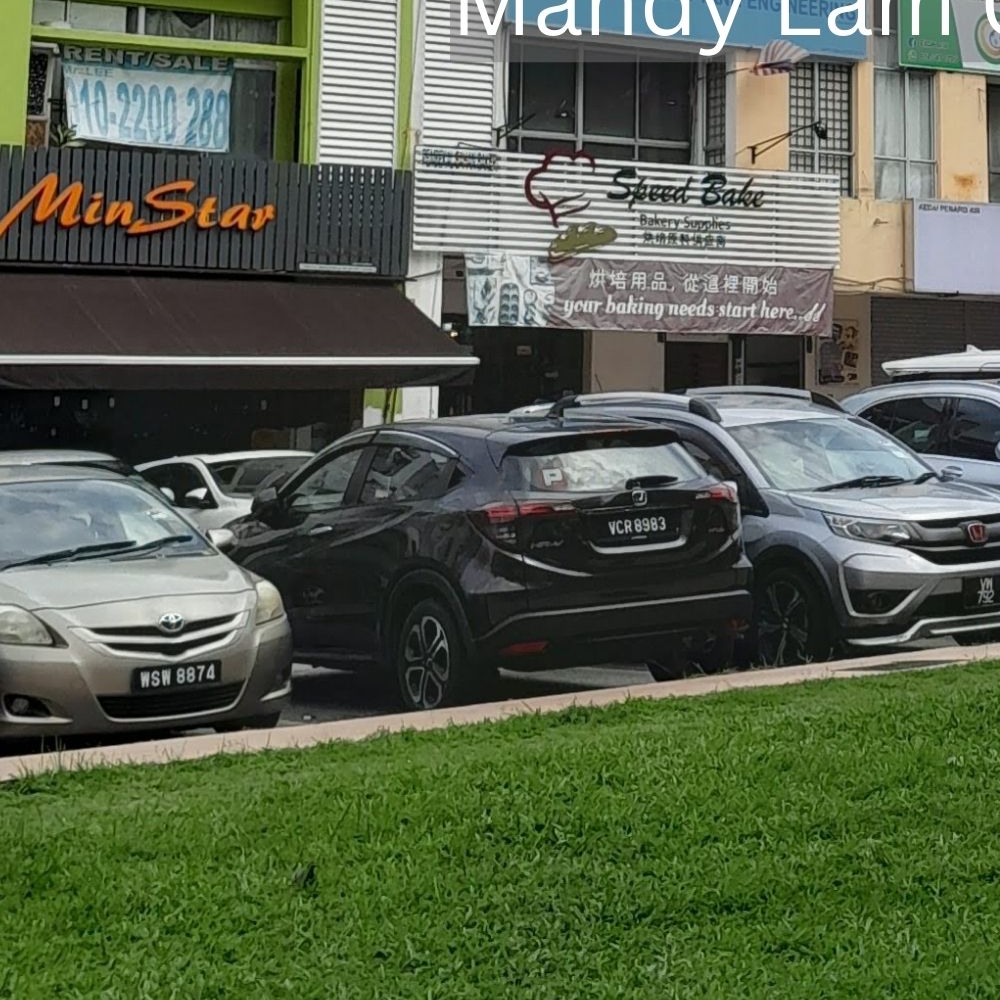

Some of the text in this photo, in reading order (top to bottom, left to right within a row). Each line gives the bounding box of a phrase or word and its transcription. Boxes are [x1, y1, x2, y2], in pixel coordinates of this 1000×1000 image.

[606, 167, 766, 210] Speed Bake
[640, 214, 682, 229] Bakery
[563, 298, 603, 319] your
[605, 294, 665, 321] baking
[668, 301, 715, 317] needs
[718, 301, 757, 318] start
[608, 516, 667, 536] VCR 8983
[140, 663, 216, 688] WSW 8874
